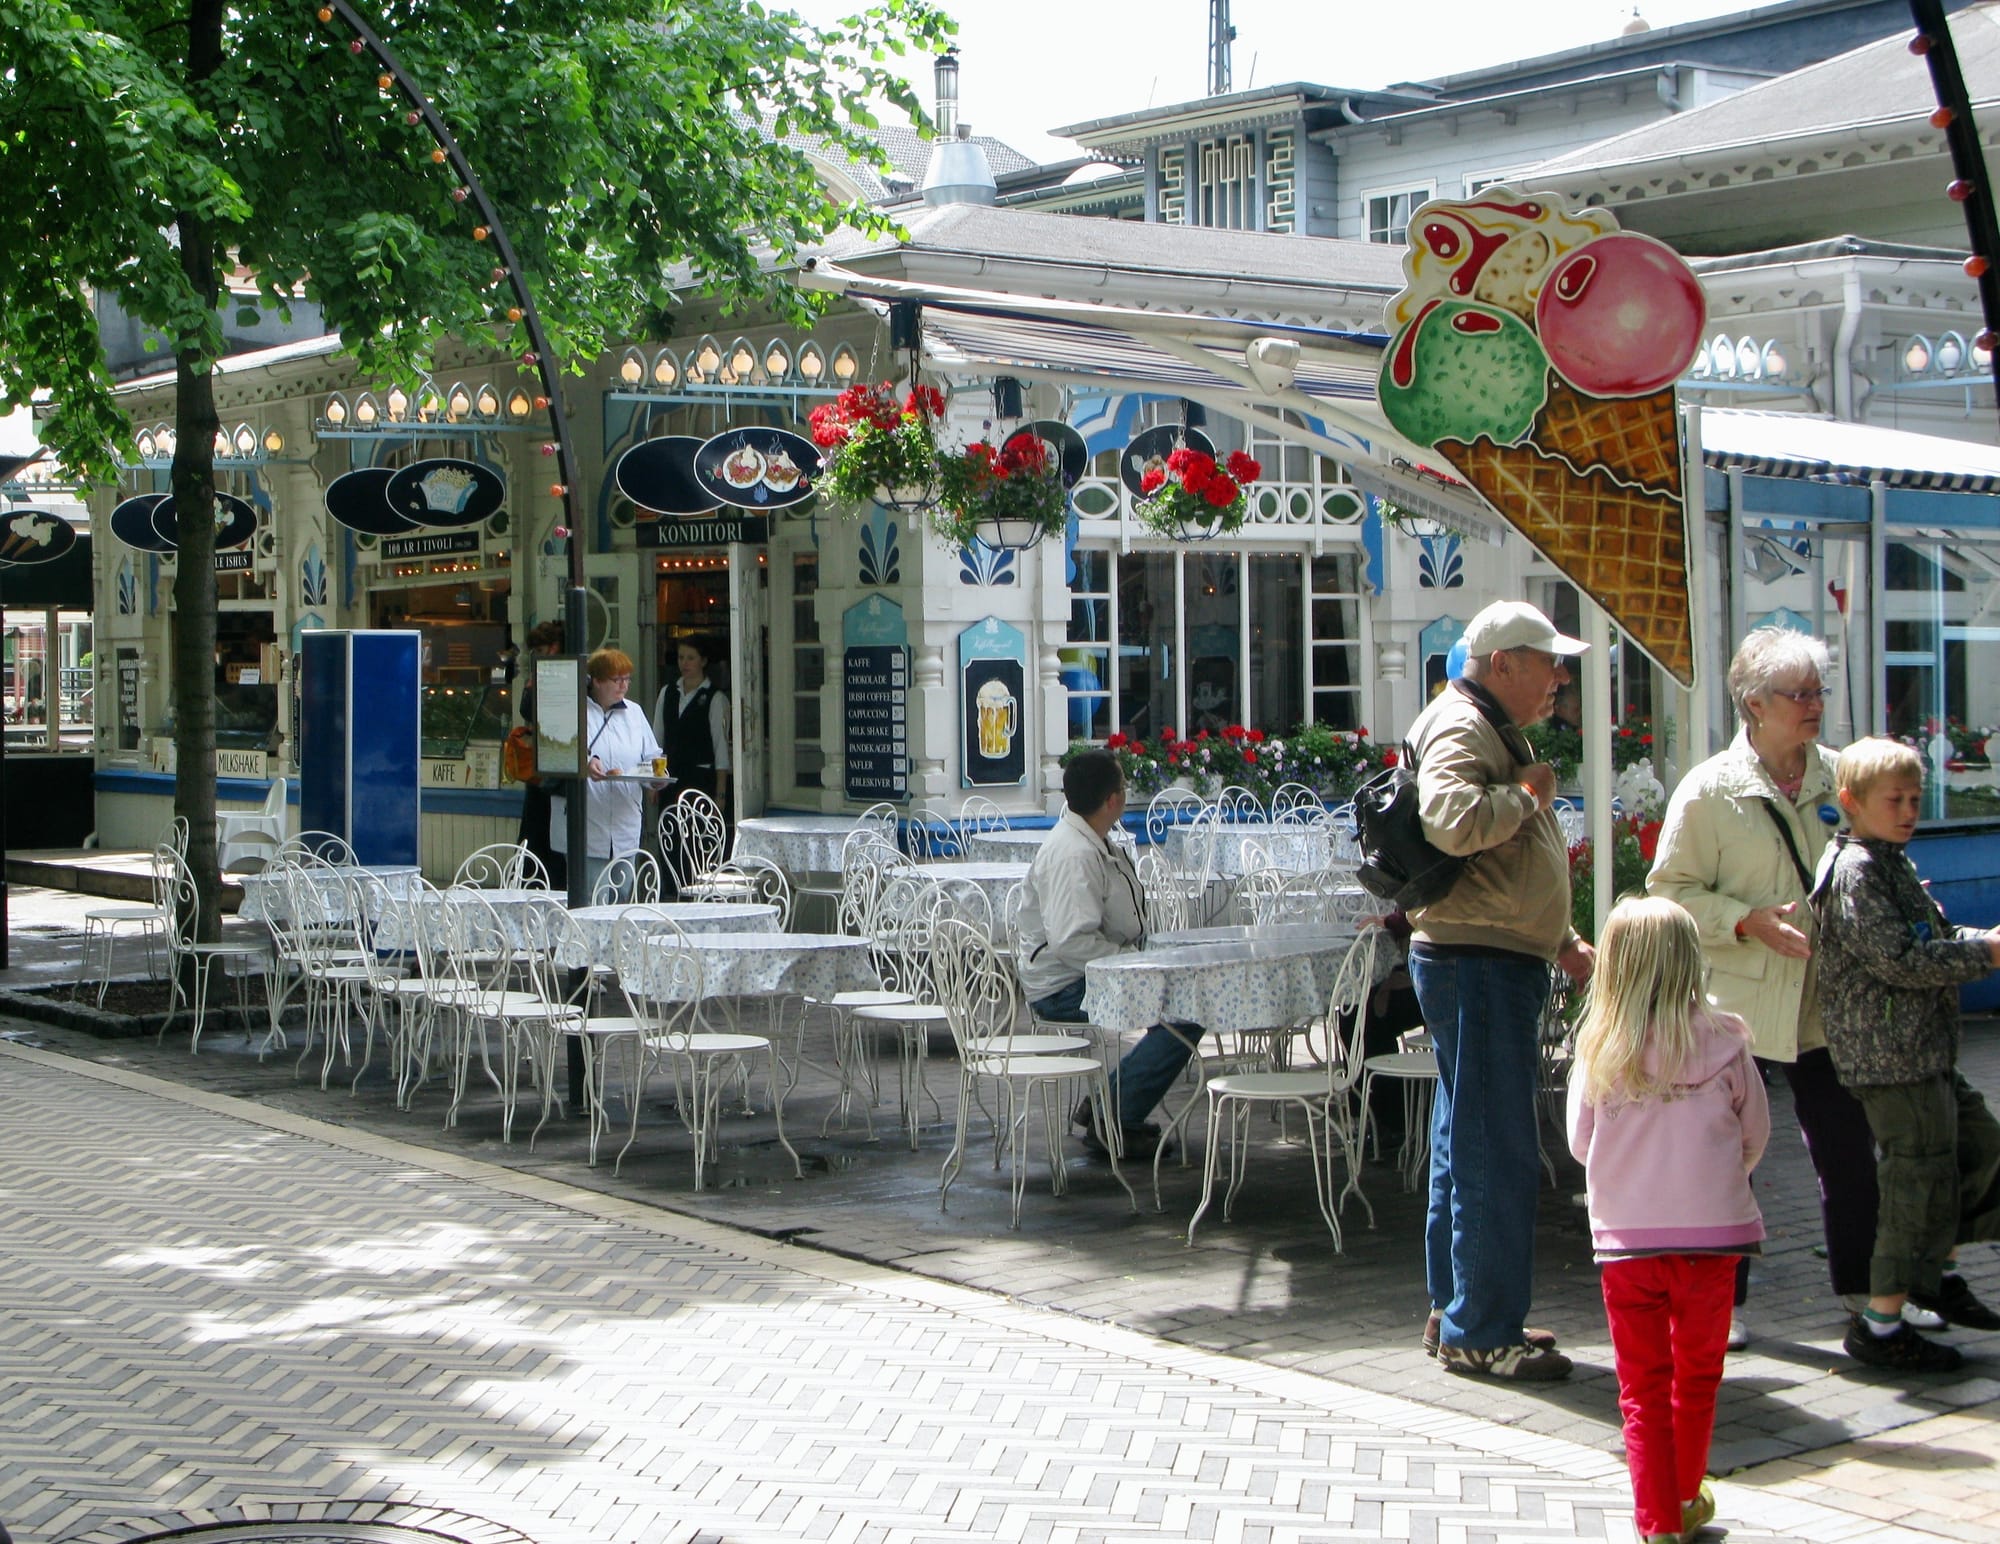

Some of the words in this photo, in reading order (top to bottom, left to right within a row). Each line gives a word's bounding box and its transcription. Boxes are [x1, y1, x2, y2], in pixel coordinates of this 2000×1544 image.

[658, 522, 743, 544] KONDITORI
[388, 543, 401, 555] 100
[404, 539, 415, 554] ÅR
[417, 540, 421, 553] I
[423, 537, 452, 553] TIVOLI
[848, 658, 871, 668] KAFFE
[848, 674, 888, 685] CHOKOLADE
[848, 691, 866, 702] IRISH
[867, 691, 892, 702] COFFEE
[848, 709, 889, 720] CAPPUCCINO
[849, 726, 866, 737] MILK
[867, 726, 890, 737] SHAKE
[849, 743, 892, 753] PANDEKAGER
[218, 753, 259, 773] MILKSHAKE
[849, 760, 874, 770] VAFLER
[432, 763, 456, 782] KAFFE
[850, 777, 891, 788] ÆBLESKIVER
